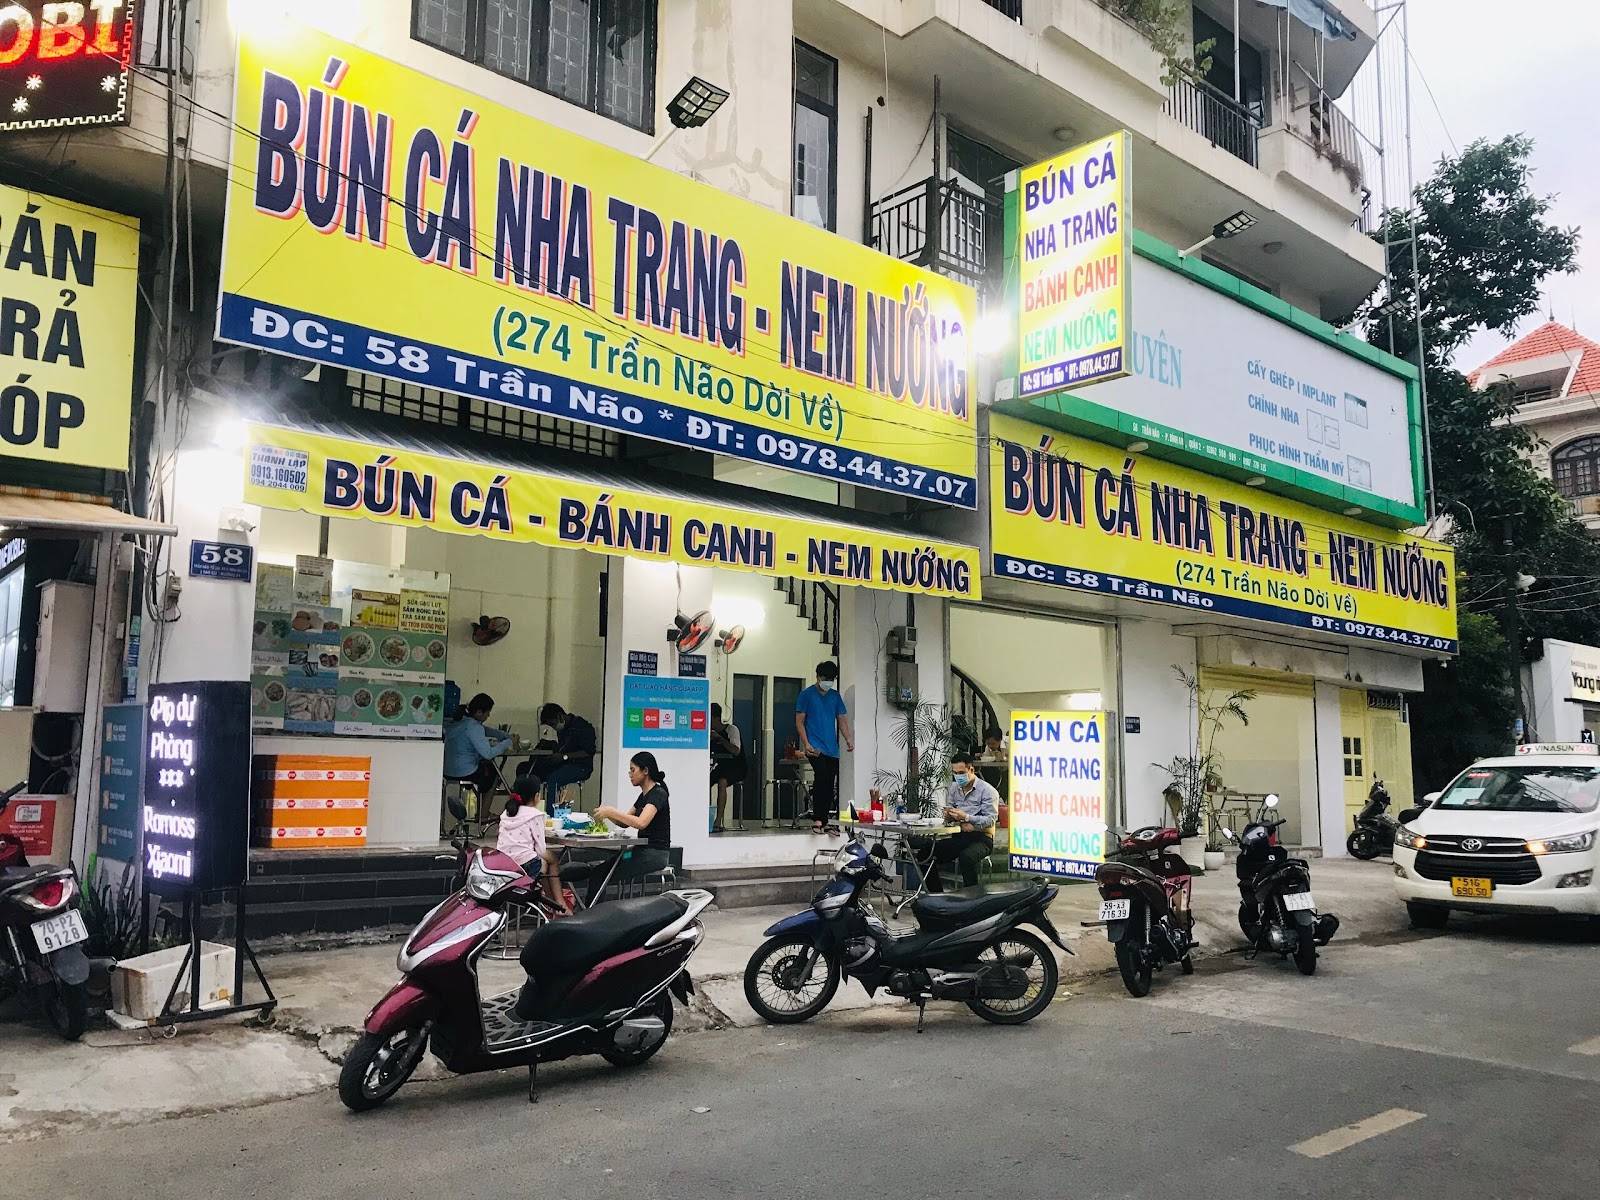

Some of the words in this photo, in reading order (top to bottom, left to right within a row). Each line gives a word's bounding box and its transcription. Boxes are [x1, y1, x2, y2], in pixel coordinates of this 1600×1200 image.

[1024, 165, 1075, 212] BÚN
[1083, 141, 1117, 194] CÁ
[0, 202, 97, 288] ÁN
[254, 57, 391, 248] BÚN
[404, 109, 477, 276] CÁ
[495, 157, 594, 311] NHA
[607, 196, 746, 357] TRANG
[780, 260, 857, 388] NEM
[865, 282, 969, 423] NƯỚNG
[1024, 223, 1057, 262] NHA
[1062, 202, 1118, 249] TRANG
[1024, 269, 1068, 313] BÁNH
[1073, 254, 1118, 299] CANH
[1023, 325, 1057, 365] NEM
[1062, 306, 1118, 353] NƯỚNG
[492, 305, 571, 362] (274
[584, 330, 660, 387] Trần
[673, 355, 734, 405] Não
[743, 376, 790, 421] Dời
[800, 390, 844, 441] Về)
[1247, 359, 1267, 380] CẤY
[1269, 371, 1295, 391] GHÉP
[1302, 383, 1337, 409] MPLANT
[0, 373, 85, 449] ÓP
[250, 307, 345, 355] ĐC:
[365, 335, 431, 374] 58
[446, 354, 553, 404] Trần
[569, 385, 644, 425] Não
[686, 415, 745, 449] ĐT:
[756, 432, 969, 499] 0978.44.37.07
[1248, 393, 1278, 418] CHỈNH
[1248, 432, 1276, 455] PHỤC
[1278, 441, 1301, 464] HÌNH
[1303, 449, 1330, 473] THẨM
[1331, 461, 1345, 477] MỸ
[251, 464, 306, 485] 0913.160502
[323, 454, 436, 523] BÚN
[450, 475, 514, 534] CÁ
[558, 493, 672, 556] BÁNH
[683, 518, 776, 570] CANH
[807, 537, 873, 581] NEM
[881, 546, 972, 595] NƯỚNG
[1003, 434, 1085, 529] BÚN
[1095, 457, 1142, 541] CÁ
[1151, 481, 1215, 557] NHA
[1219, 500, 1309, 580] TRANG
[1328, 530, 1378, 594] NEM
[1382, 541, 1450, 610] NƯỚNG
[201, 544, 244, 566] 58
[1006, 559, 1055, 581] ĐC:
[1065, 571, 1100, 588] 58
[1107, 576, 1164, 599] Trần
[1172, 589, 1214, 608] Não
[1176, 559, 1216, 586] (274
[1221, 569, 1262, 596] Trần
[1267, 578, 1299, 603] Não
[1304, 587, 1330, 609] Dời
[1334, 592, 1358, 619] Về)
[1311, 615, 1340, 631] ĐT:
[1345, 621, 1451, 650] 0978.44.37.07
[1571, 671, 1595, 694] Young
[1013, 714, 1061, 742] BÚN
[1069, 714, 1100, 744] CÁ
[150, 731, 194, 766] Phòng
[1534, 744, 1575, 752] VINASUN
[1013, 755, 1043, 778] NHA
[1048, 756, 1101, 781] TRANG
[144, 806, 196, 840] Romoss
[1059, 794, 1101, 819] CANH
[1013, 826, 1044, 851] NEM
[1021, 856, 1029, 869] 58
[1463, 878, 1480, 887] 51G
[39, 914, 76, 937] 70-P2
[44, 927, 80, 949] 9128
